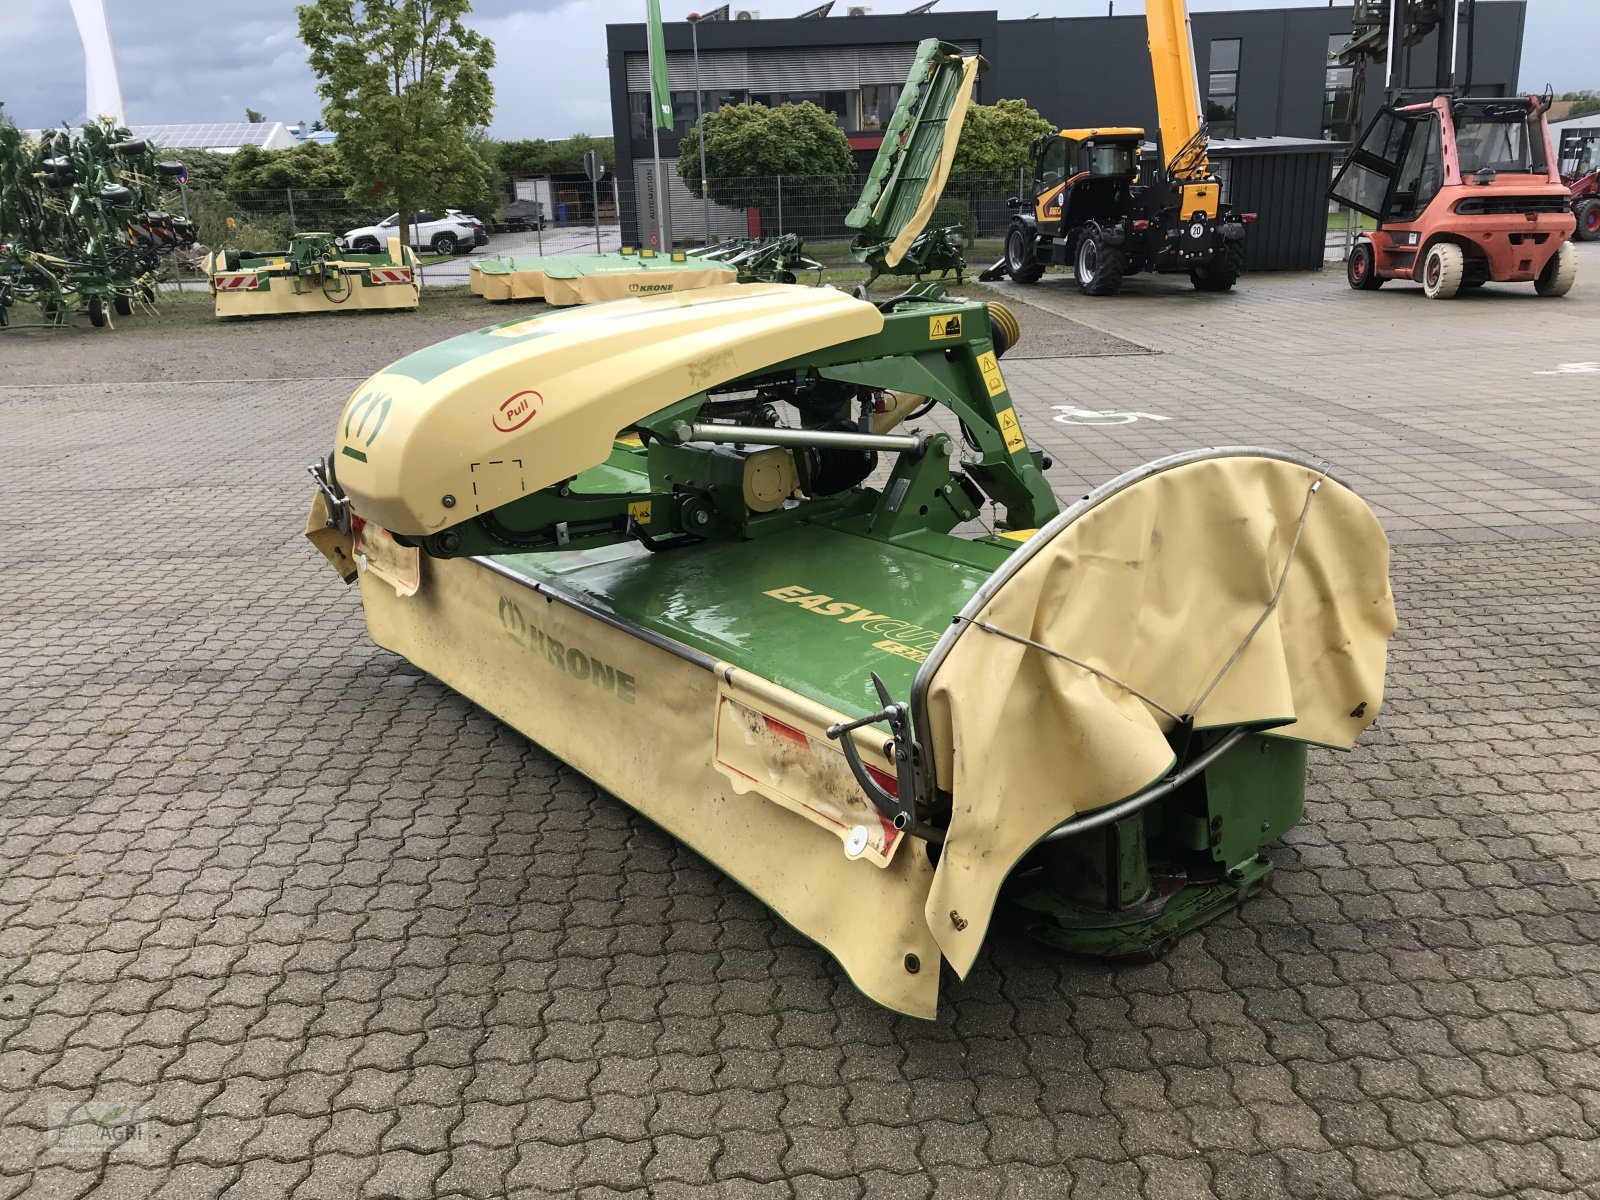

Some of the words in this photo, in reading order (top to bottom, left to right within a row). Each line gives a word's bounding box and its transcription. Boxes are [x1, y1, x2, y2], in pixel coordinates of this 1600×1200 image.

[646, 169, 655, 219] AUTOMATION
[1192, 226, 1201, 236] 20
[640, 284, 674, 292] KRONE
[506, 399, 529, 422] Pull
[529, 623, 637, 705] KRONE
